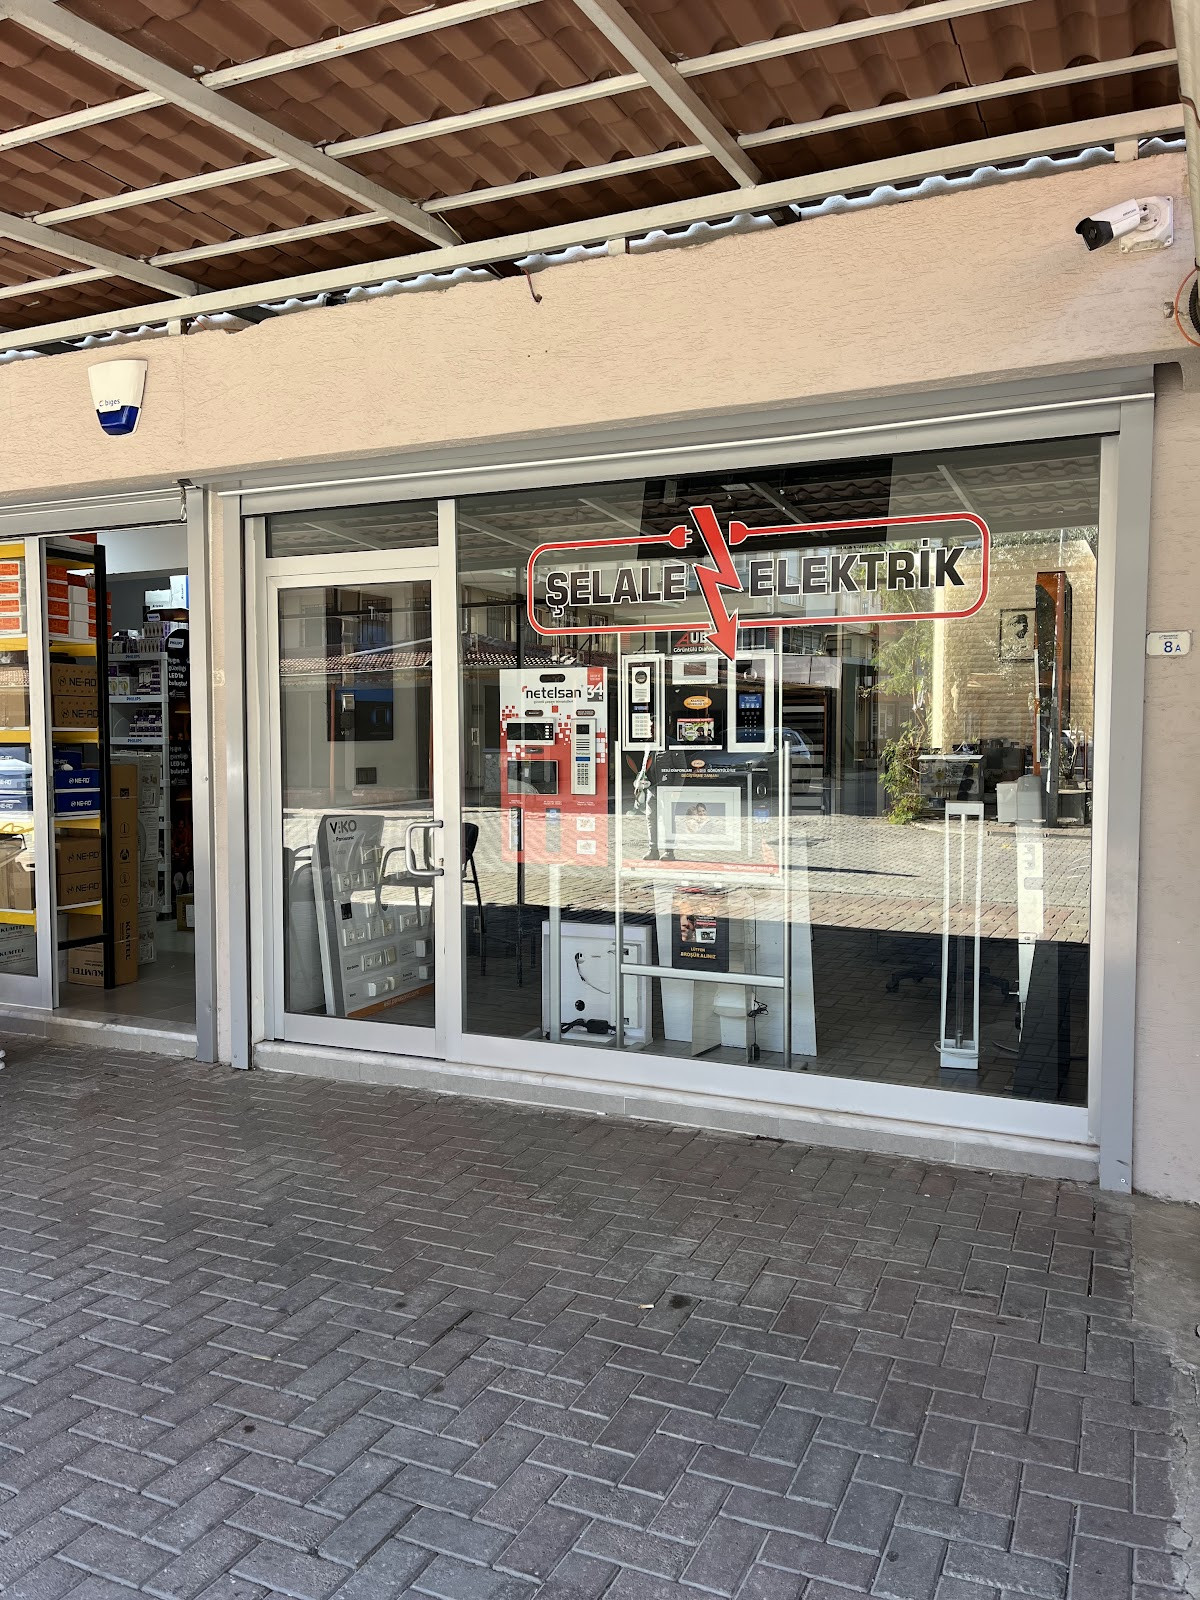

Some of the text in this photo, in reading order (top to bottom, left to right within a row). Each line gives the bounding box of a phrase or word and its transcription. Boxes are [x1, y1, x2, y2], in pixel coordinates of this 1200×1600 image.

[545, 537, 966, 618] ŞELALE ELEKTRİK
[1164, 640, 1182, 653] 8 A
[526, 686, 582, 699] netelsan
[587, 682, 604, 699] 34
